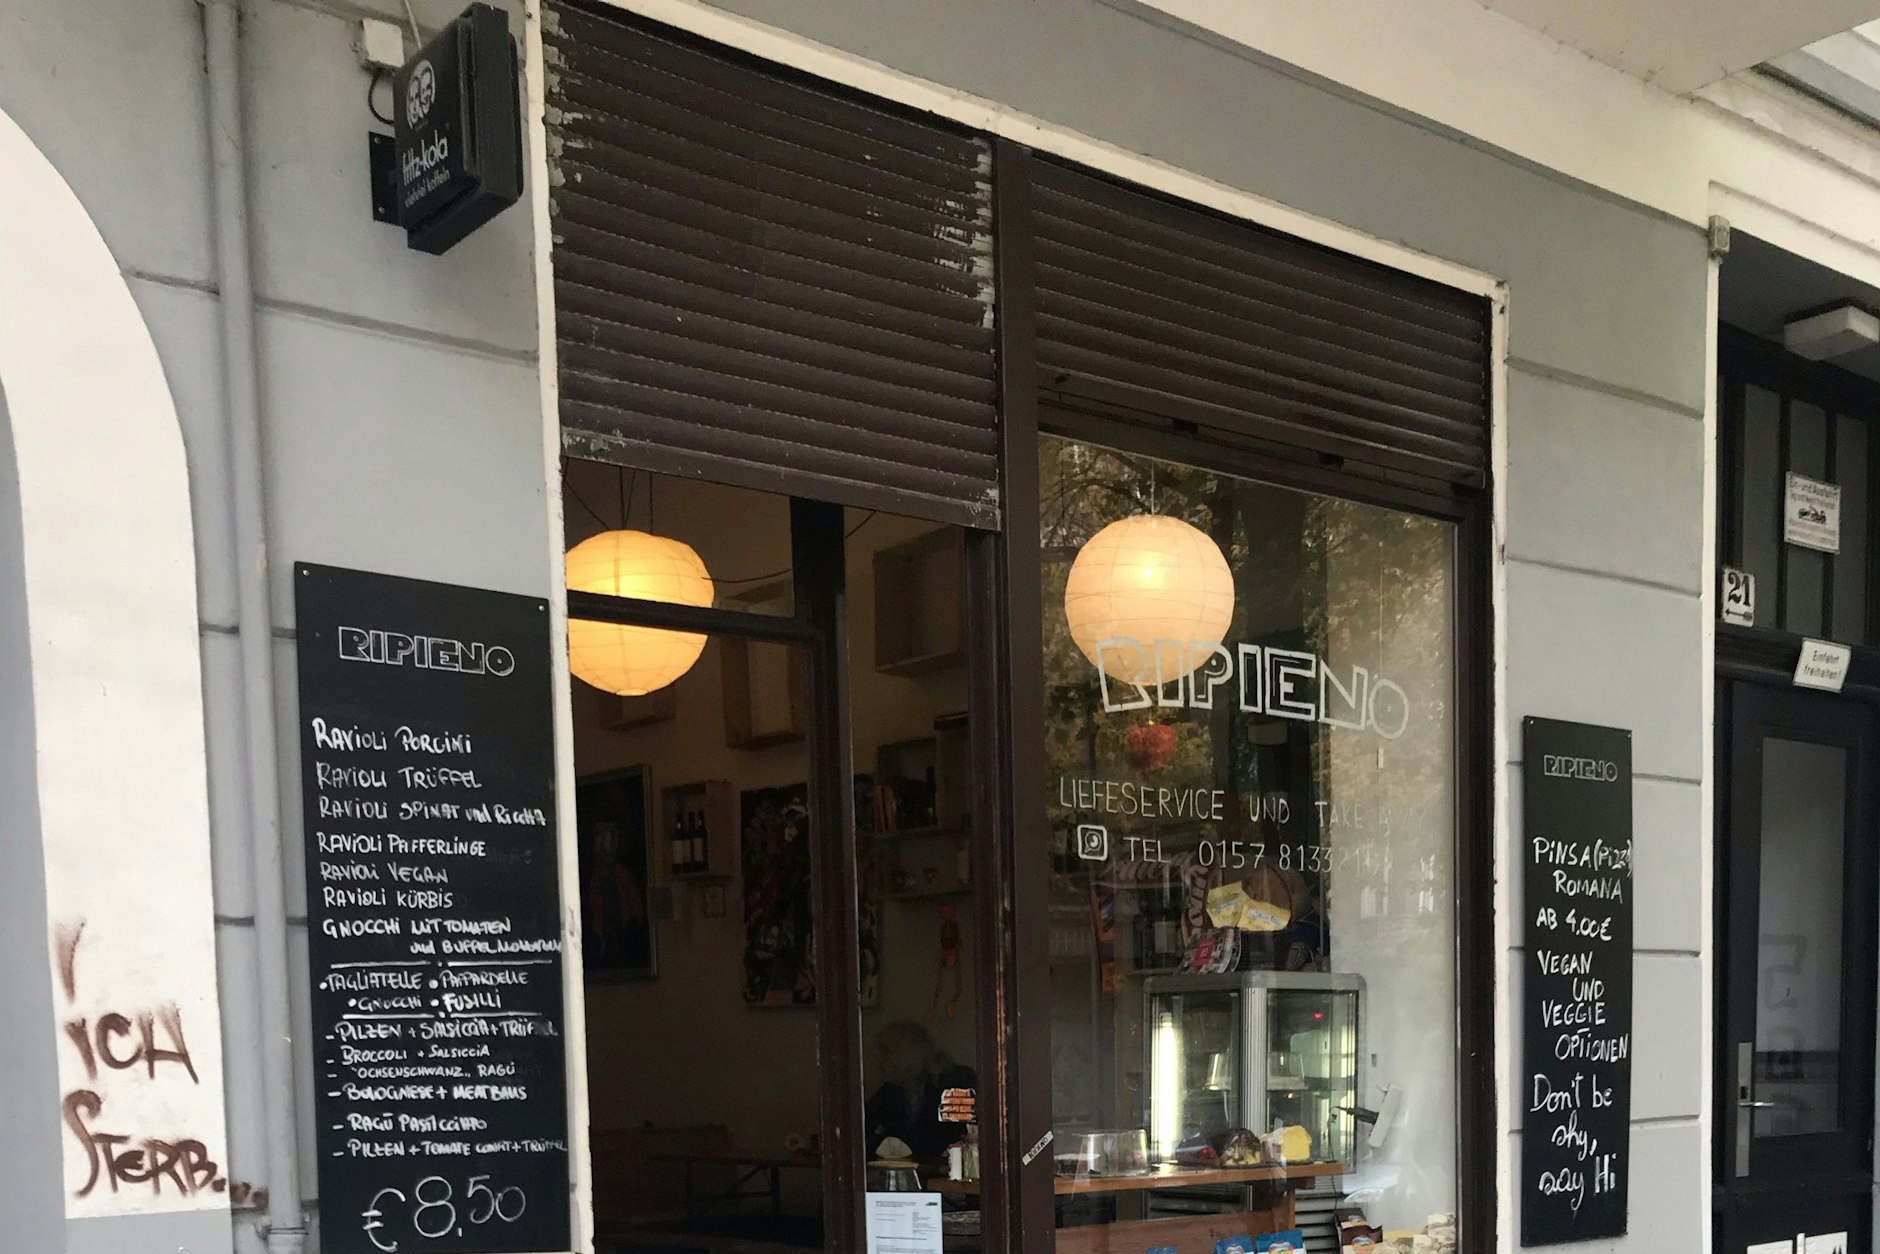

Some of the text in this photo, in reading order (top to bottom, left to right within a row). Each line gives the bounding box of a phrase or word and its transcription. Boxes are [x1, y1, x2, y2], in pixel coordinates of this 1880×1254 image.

[1727, 571, 1751, 607] 21
[338, 626, 515, 676] RIPIENO
[1095, 636, 1409, 741] RIPIENO
[1544, 755, 1618, 782] RIPIENO
[1059, 776, 1226, 821] LIEFESERVICE
[1249, 796, 1290, 824] UND
[1123, 836, 1172, 864] TEL
[1199, 840, 1265, 871] 0157
[387, 863, 449, 884] VEGAN
[1553, 870, 1623, 904] ROMANA
[1536, 907, 1558, 930] AB
[1537, 949, 1593, 975] VEGAN
[1573, 977, 1604, 1001] UND
[1542, 999, 1606, 1028] VEGGIE
[64, 1002, 199, 1084] ICH
[1530, 1072, 1613, 1113] Don't be
[1539, 1153, 1617, 1214] say Hi
